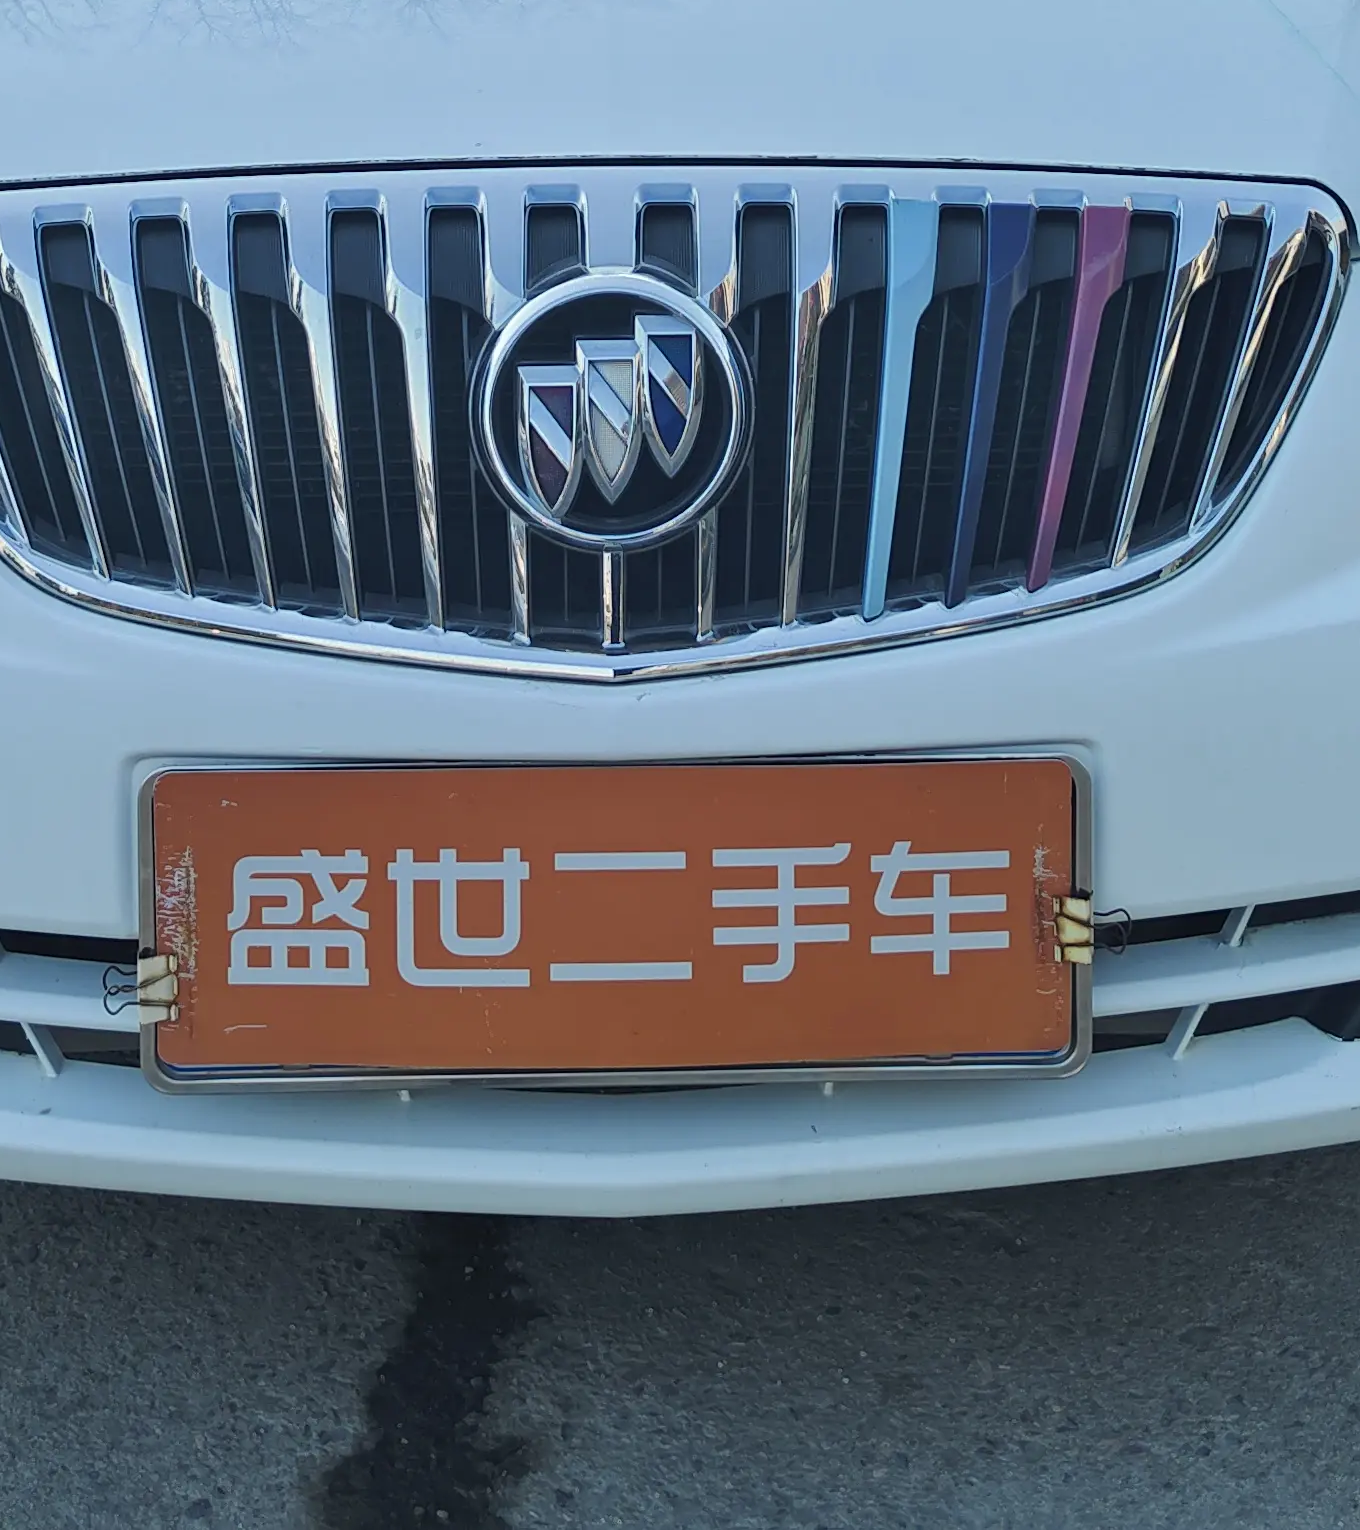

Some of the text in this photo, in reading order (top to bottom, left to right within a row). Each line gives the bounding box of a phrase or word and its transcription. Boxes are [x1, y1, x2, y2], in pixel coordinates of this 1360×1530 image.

[227, 841, 1011, 988] 盛世二手车
